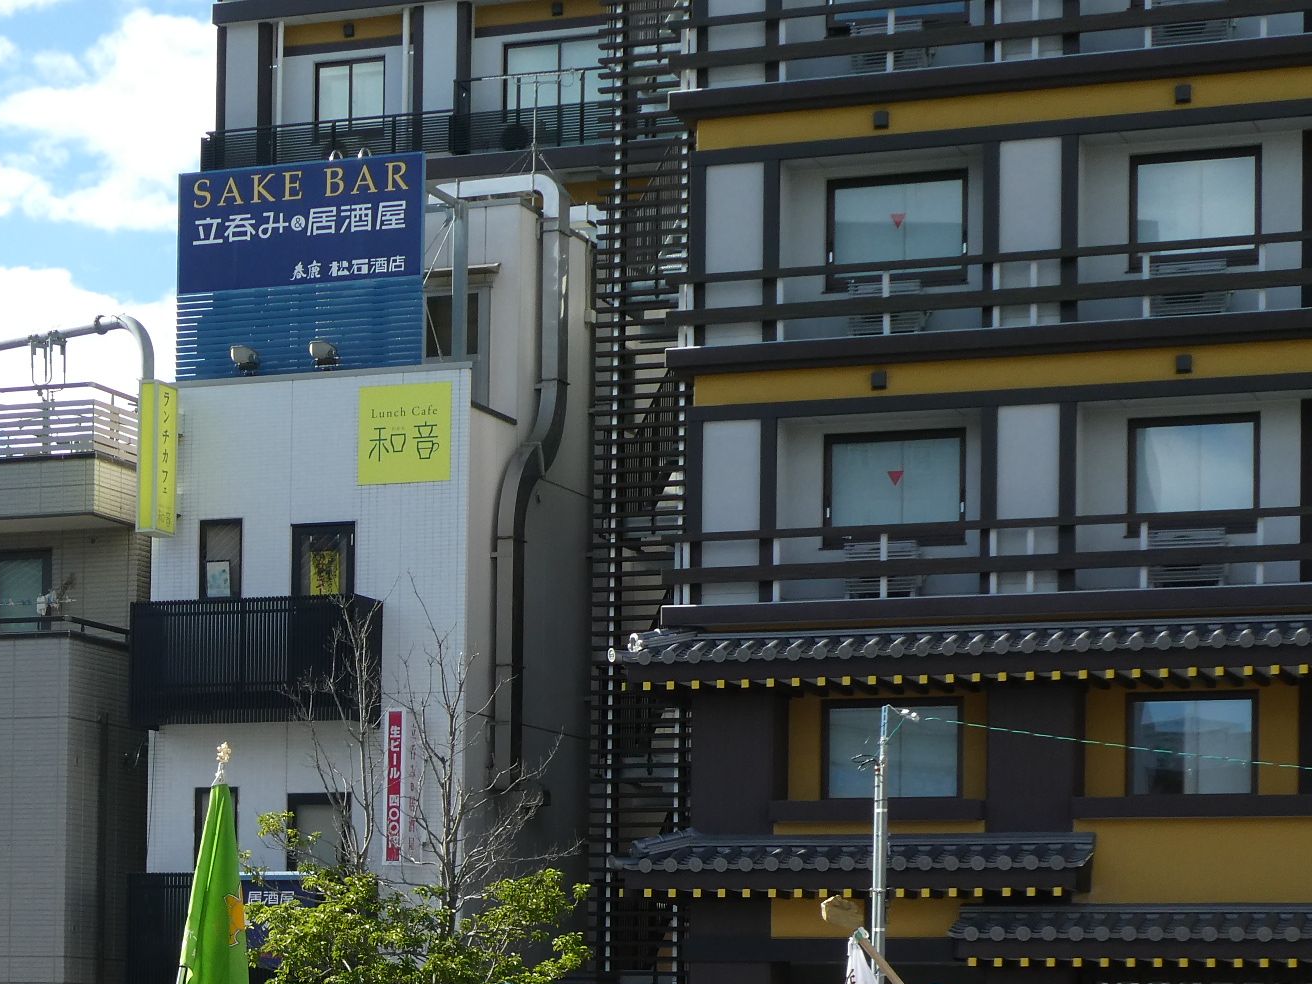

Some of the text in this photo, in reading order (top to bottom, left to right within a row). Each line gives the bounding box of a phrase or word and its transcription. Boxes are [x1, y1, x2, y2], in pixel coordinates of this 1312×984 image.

[193, 161, 409, 208] SAKE BAR
[370, 404, 438, 419] Lunch Cafe
[162, 392, 172, 494] ランチカフェ
[368, 420, 440, 462] 和音
[389, 725, 401, 779] 生ビール
